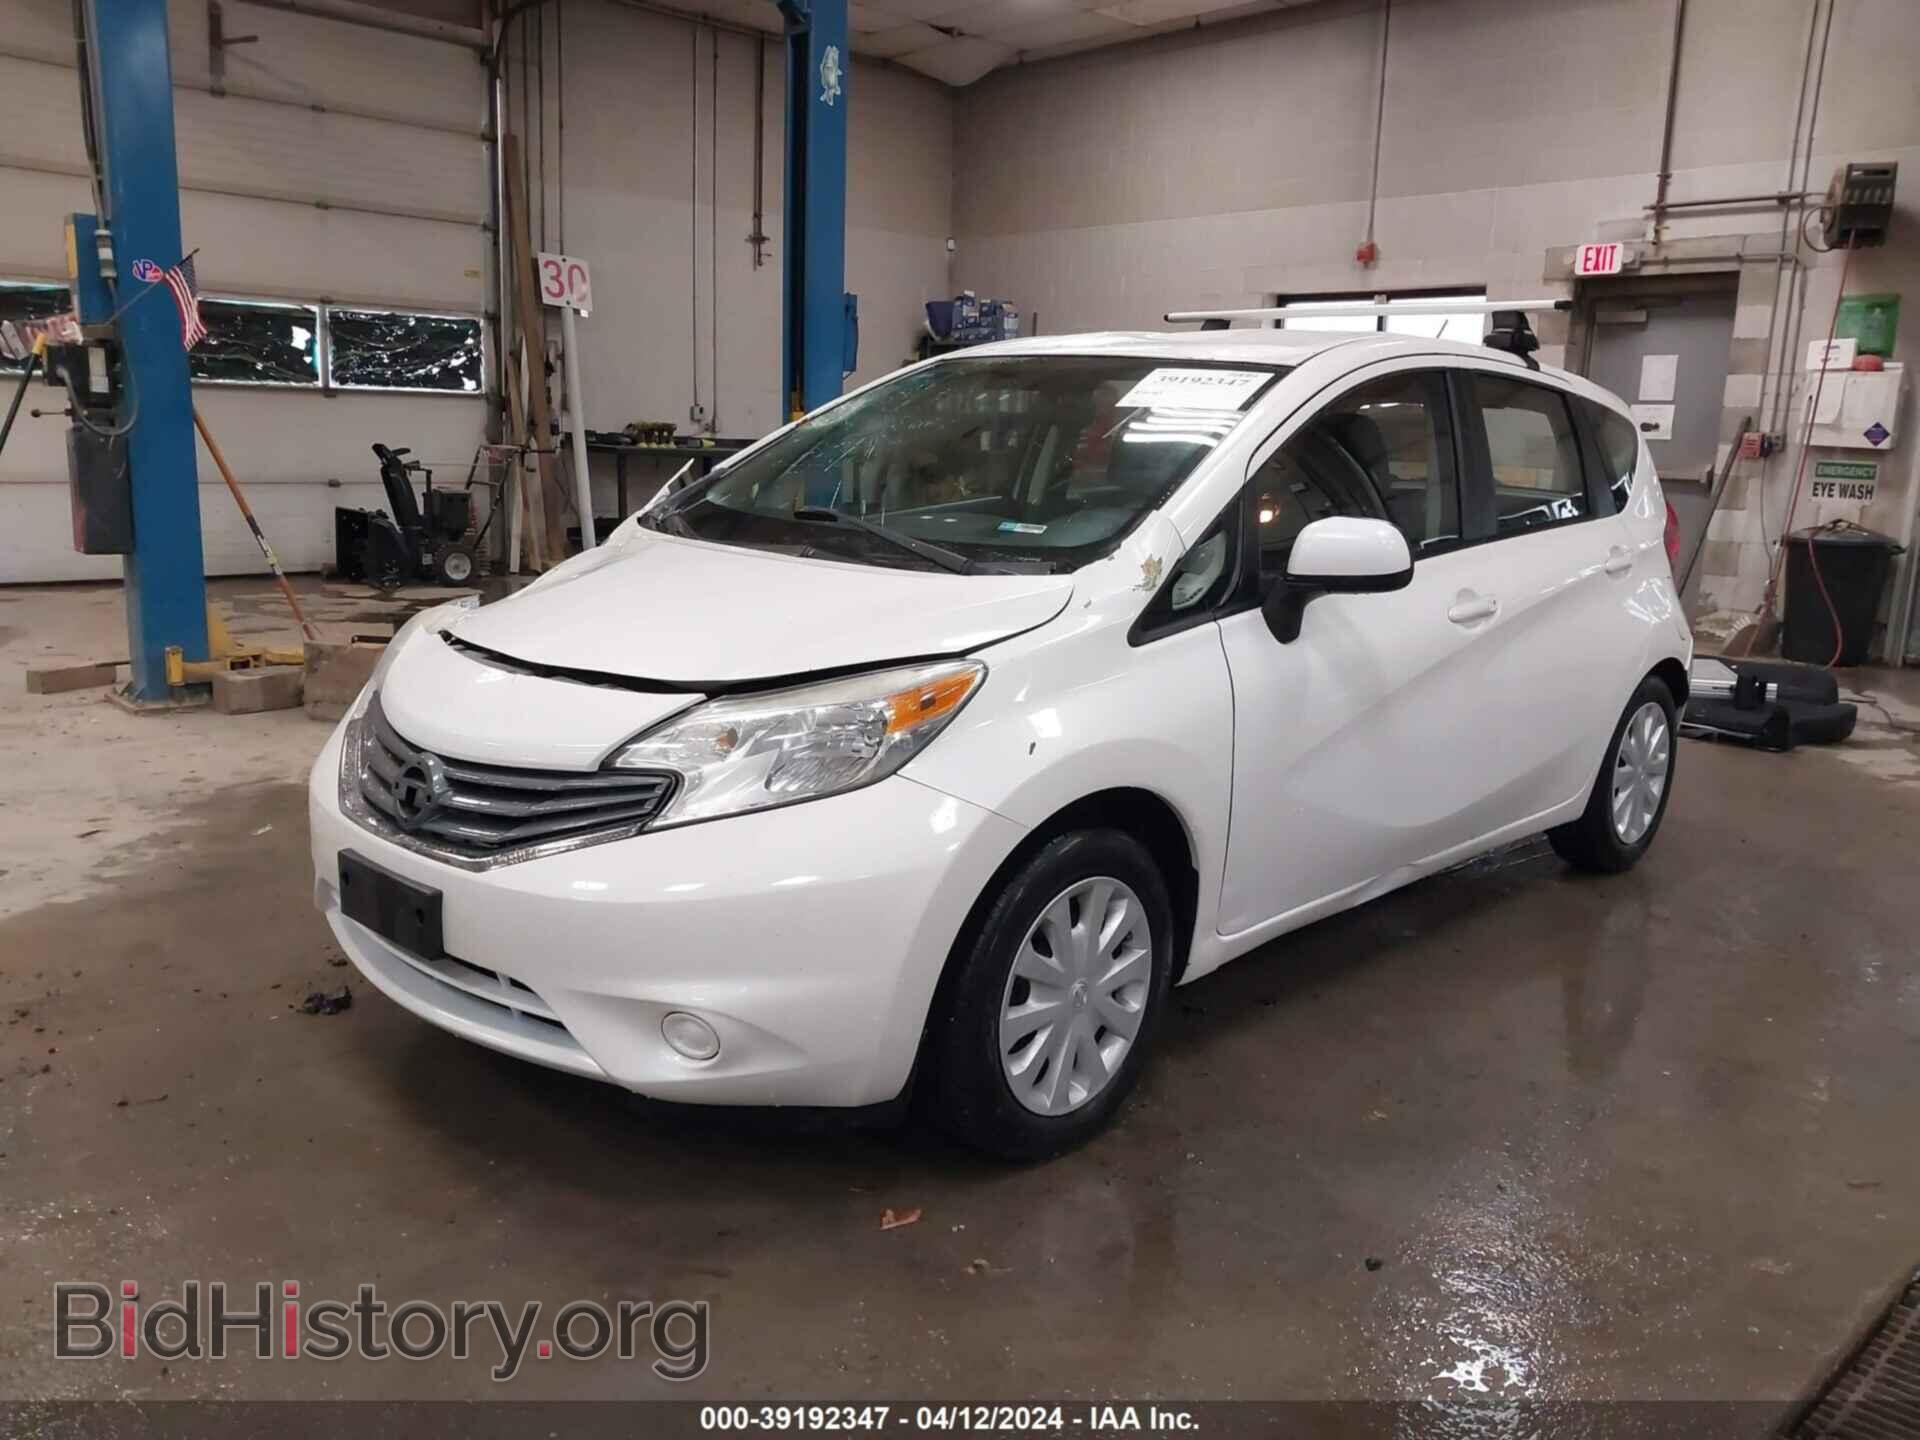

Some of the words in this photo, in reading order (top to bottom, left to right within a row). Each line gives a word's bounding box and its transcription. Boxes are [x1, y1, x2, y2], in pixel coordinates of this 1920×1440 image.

[1583, 244, 1617, 272] EXIT
[543, 260, 587, 303] 30
[1812, 482, 1836, 498] EYE
[1839, 483, 1875, 500] WASH
